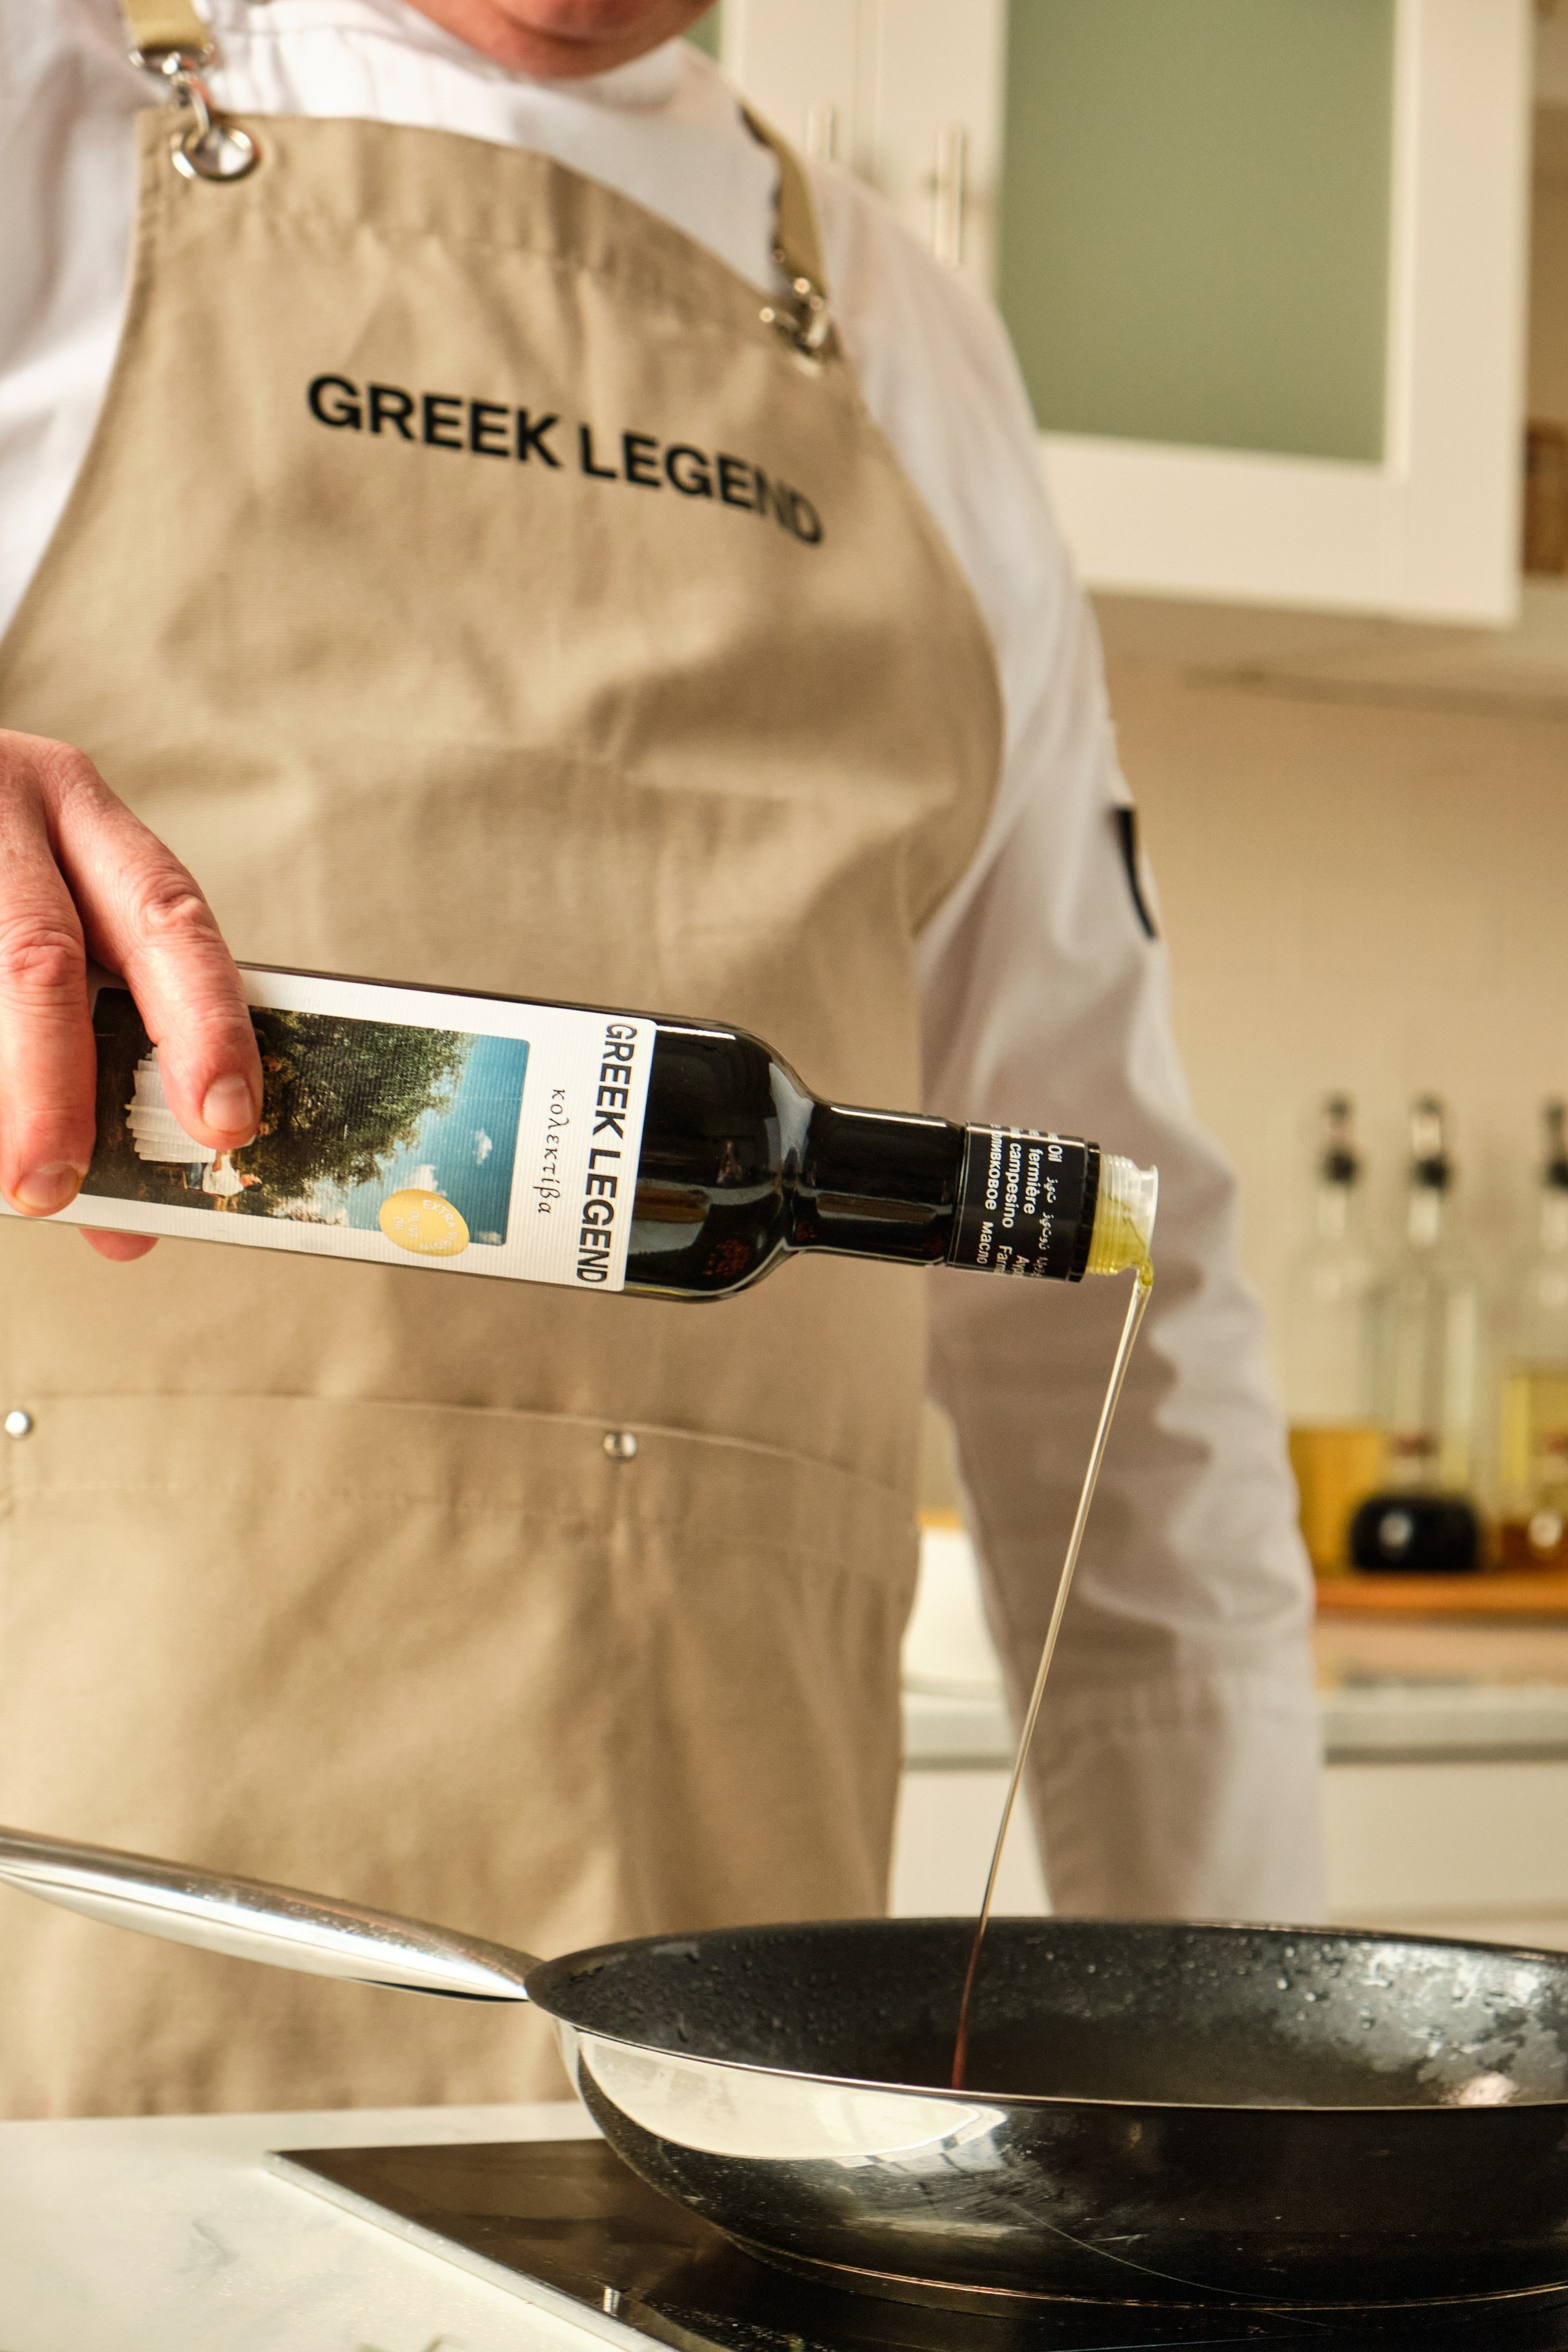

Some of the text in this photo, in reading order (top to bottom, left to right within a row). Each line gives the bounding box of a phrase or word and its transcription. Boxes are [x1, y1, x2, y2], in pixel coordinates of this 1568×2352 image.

[308, 375, 824, 547] GREEK LEGEND
[576, 1023, 638, 1283] GREEK LEGEND
[985, 1131, 1003, 1210] оливковое
[1023, 1148, 1043, 1214] fermière
[1048, 1145, 1063, 1162] Oil
[1002, 1143, 1022, 1228] campesino
[393, 1216, 405, 1231] OIL
[408, 1210, 421, 1238] OLIVE
[420, 1199, 458, 1250] EXTRA VIRGIN
[976, 1221, 993, 1264] масло
